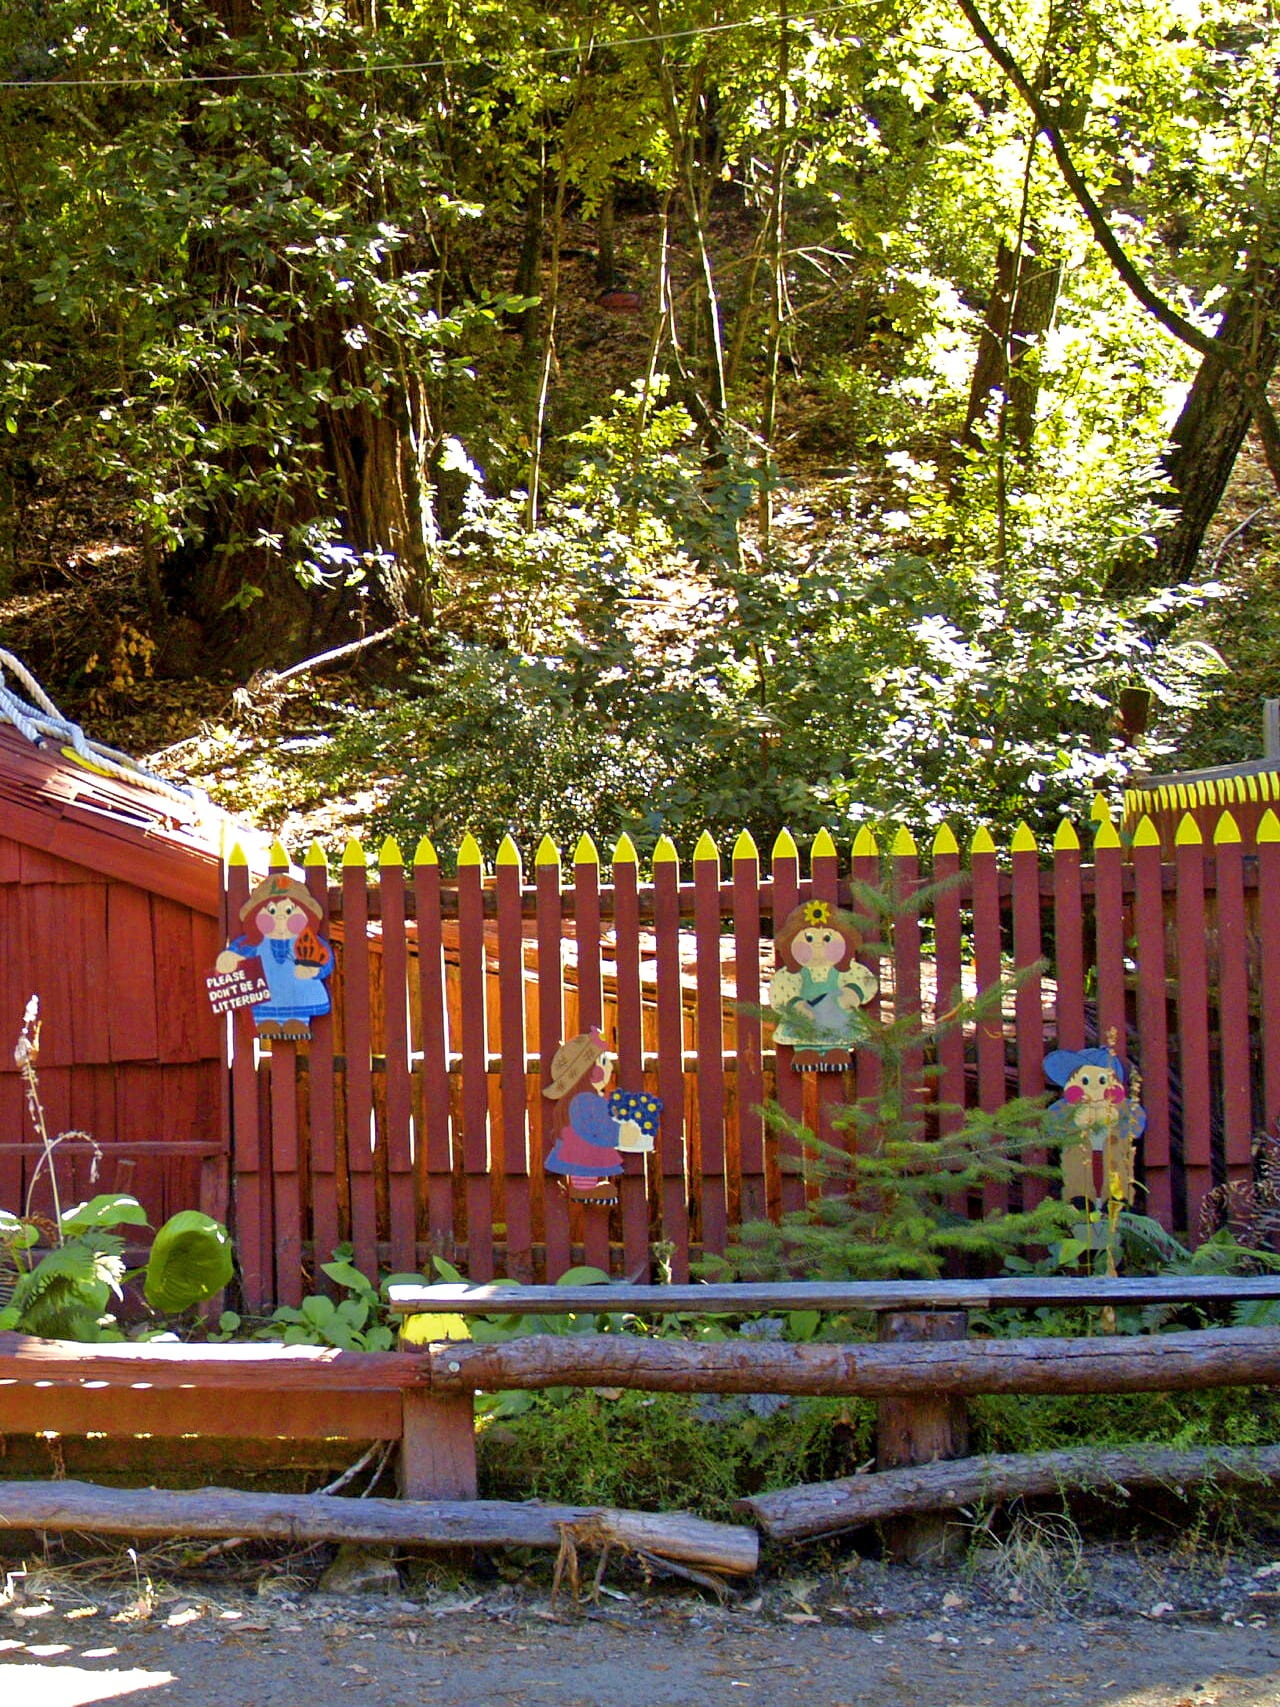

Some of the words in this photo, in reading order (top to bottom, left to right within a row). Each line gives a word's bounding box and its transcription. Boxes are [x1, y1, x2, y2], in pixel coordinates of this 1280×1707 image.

[206, 970, 246, 988] PLEASE
[209, 984, 239, 1002] DON'T
[240, 980, 254, 993] BE
[257, 978, 266, 989] A
[212, 989, 271, 1014] LITTERBUG
